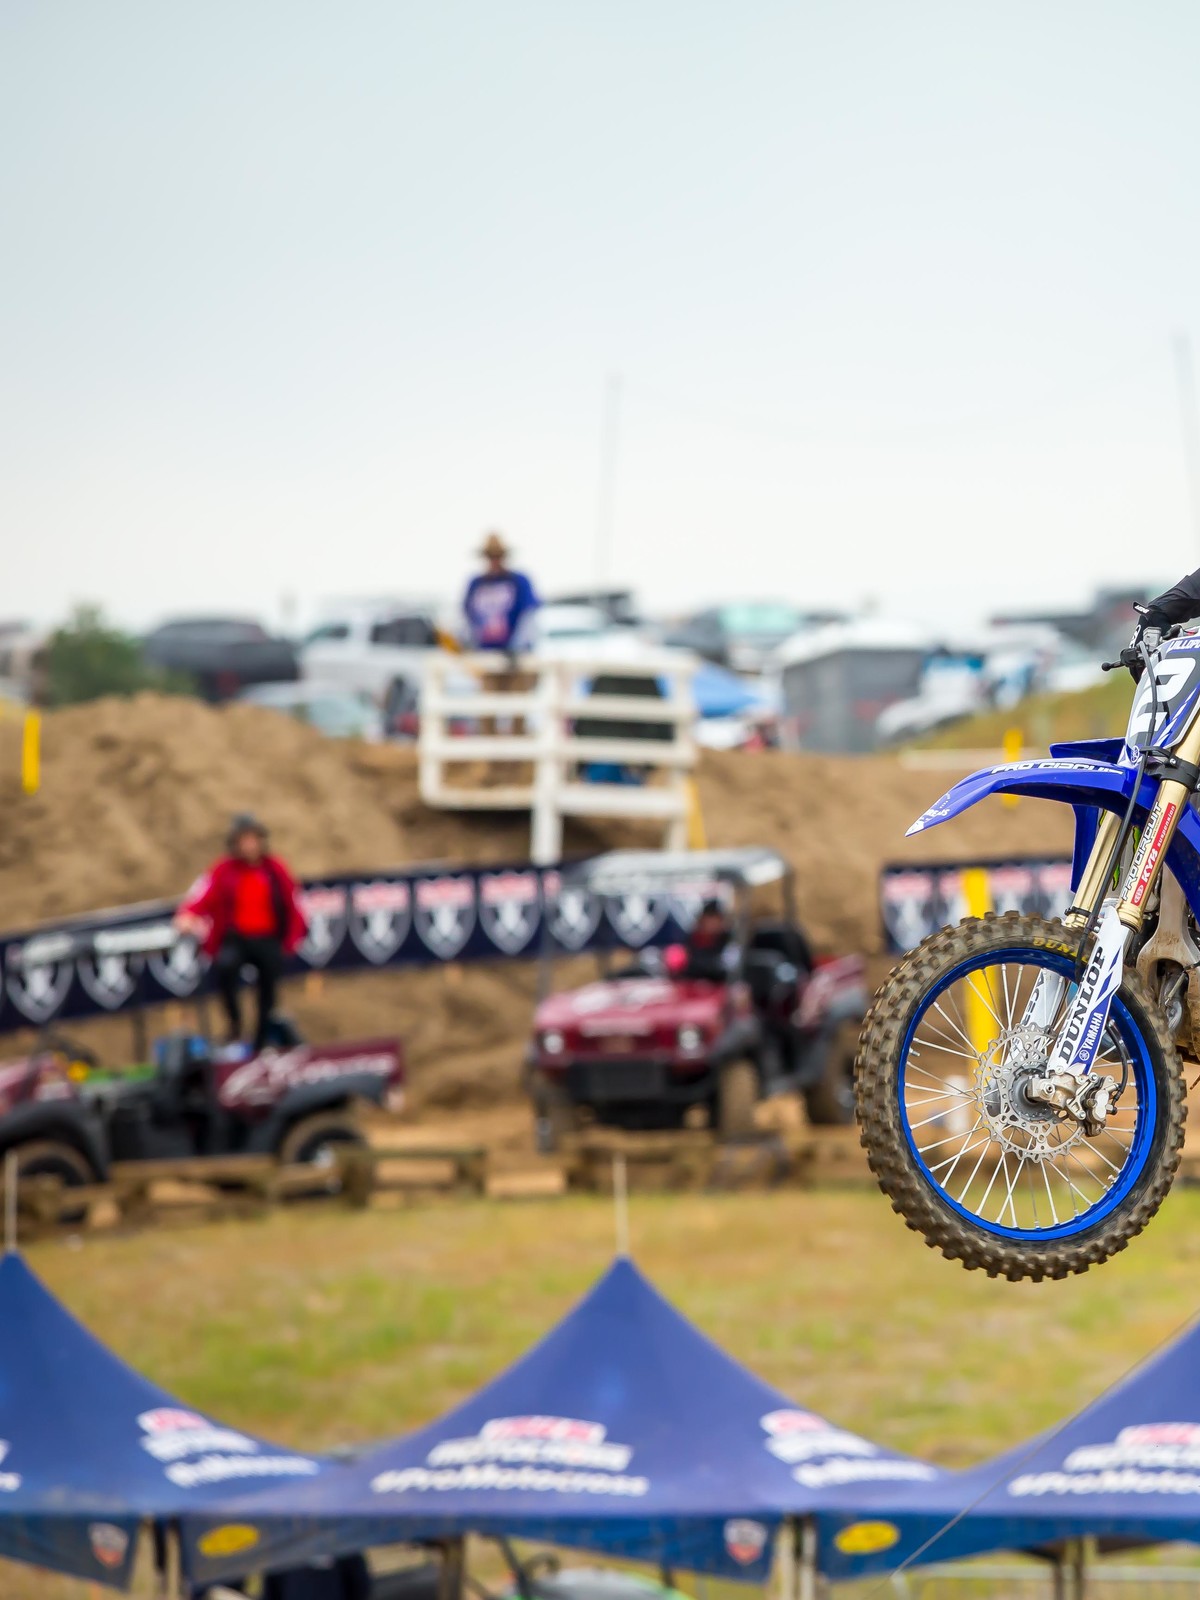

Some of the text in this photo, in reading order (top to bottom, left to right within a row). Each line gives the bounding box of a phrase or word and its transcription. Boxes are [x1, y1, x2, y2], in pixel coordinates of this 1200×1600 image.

[1129, 657, 1197, 732] 2
[990, 762, 1124, 775] PRO CIRCUIT
[1121, 801, 1163, 901] PRO CIRCUIT
[1141, 805, 1176, 884] KYB suspension
[1058, 946, 1106, 1065] DUNLOP
[1083, 1012, 1104, 1051] YAMAHA
